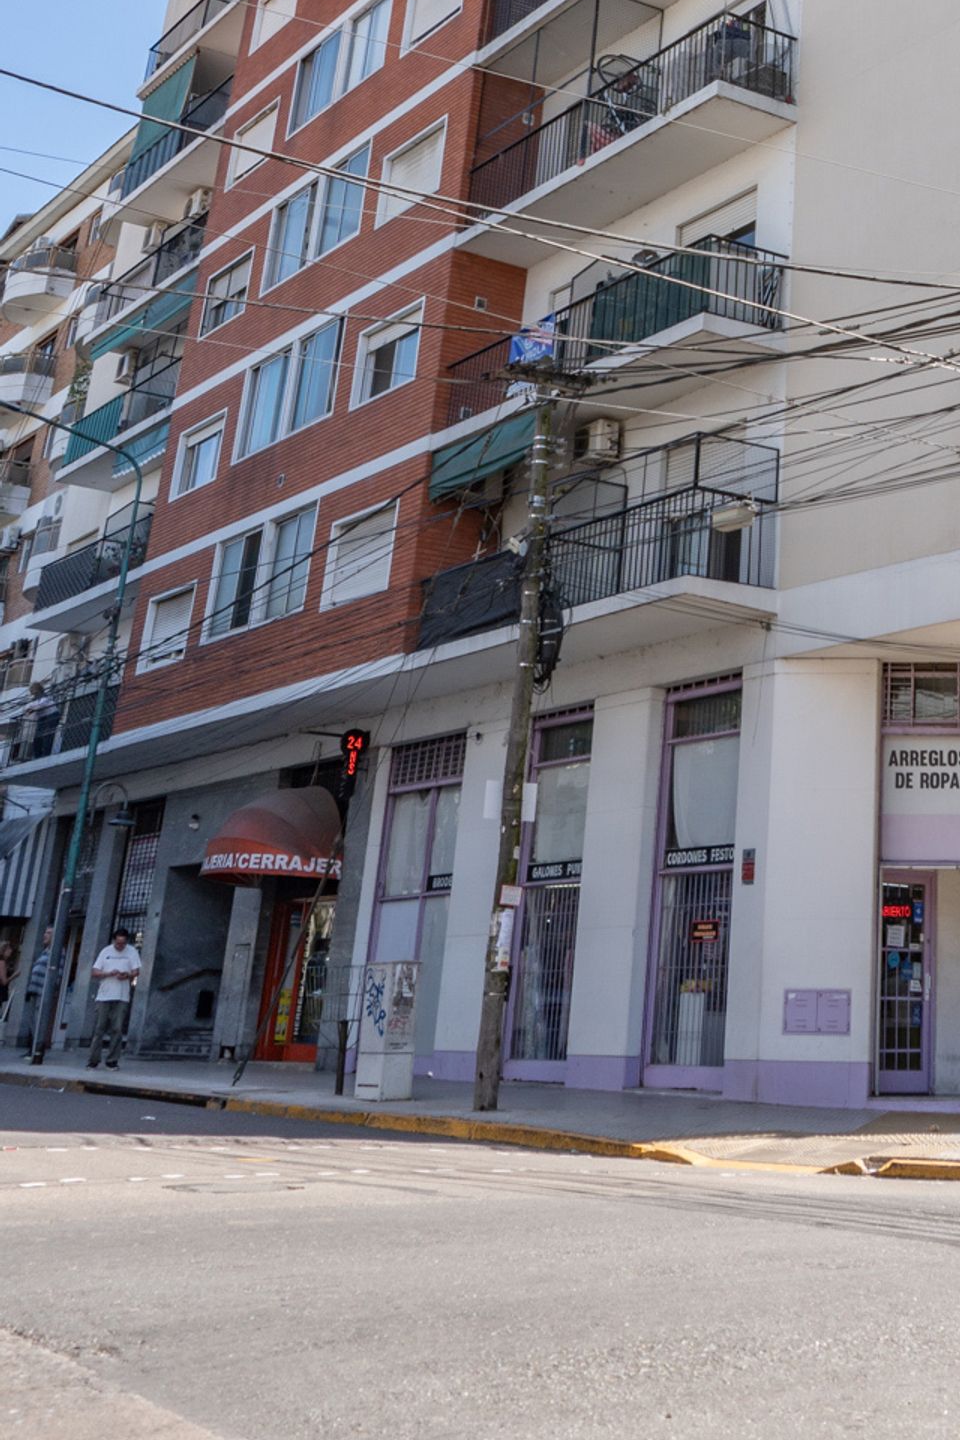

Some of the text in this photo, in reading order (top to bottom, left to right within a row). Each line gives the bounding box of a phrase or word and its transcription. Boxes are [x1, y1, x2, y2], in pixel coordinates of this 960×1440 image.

[347, 736, 362, 750] 24
[895, 772, 960, 789] DE ROPA
[667, 849, 708, 866] CORDONES
